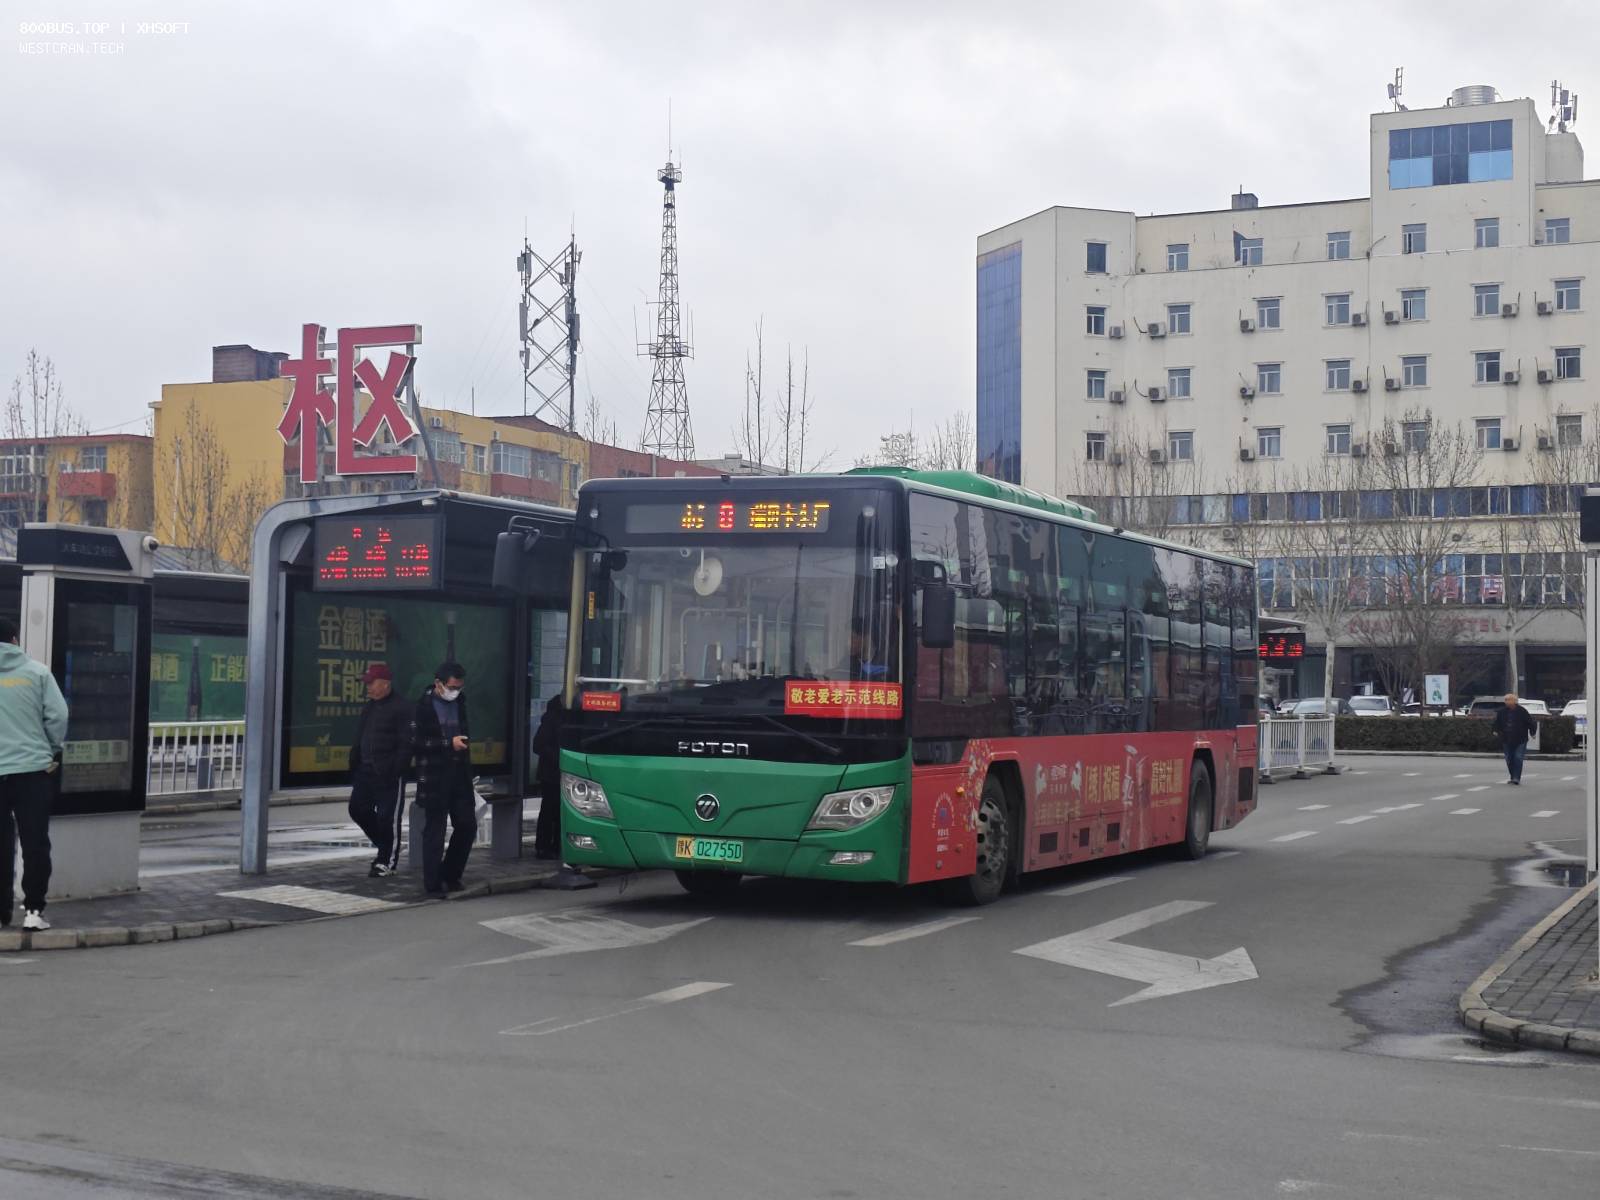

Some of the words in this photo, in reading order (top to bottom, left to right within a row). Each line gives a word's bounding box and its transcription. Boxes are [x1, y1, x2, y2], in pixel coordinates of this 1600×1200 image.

[276, 323, 421, 483] 枢
[317, 659, 387, 702] 正能
[791, 687, 899, 706] 敬老爱老示范线路
[678, 741, 749, 755] FOTON
